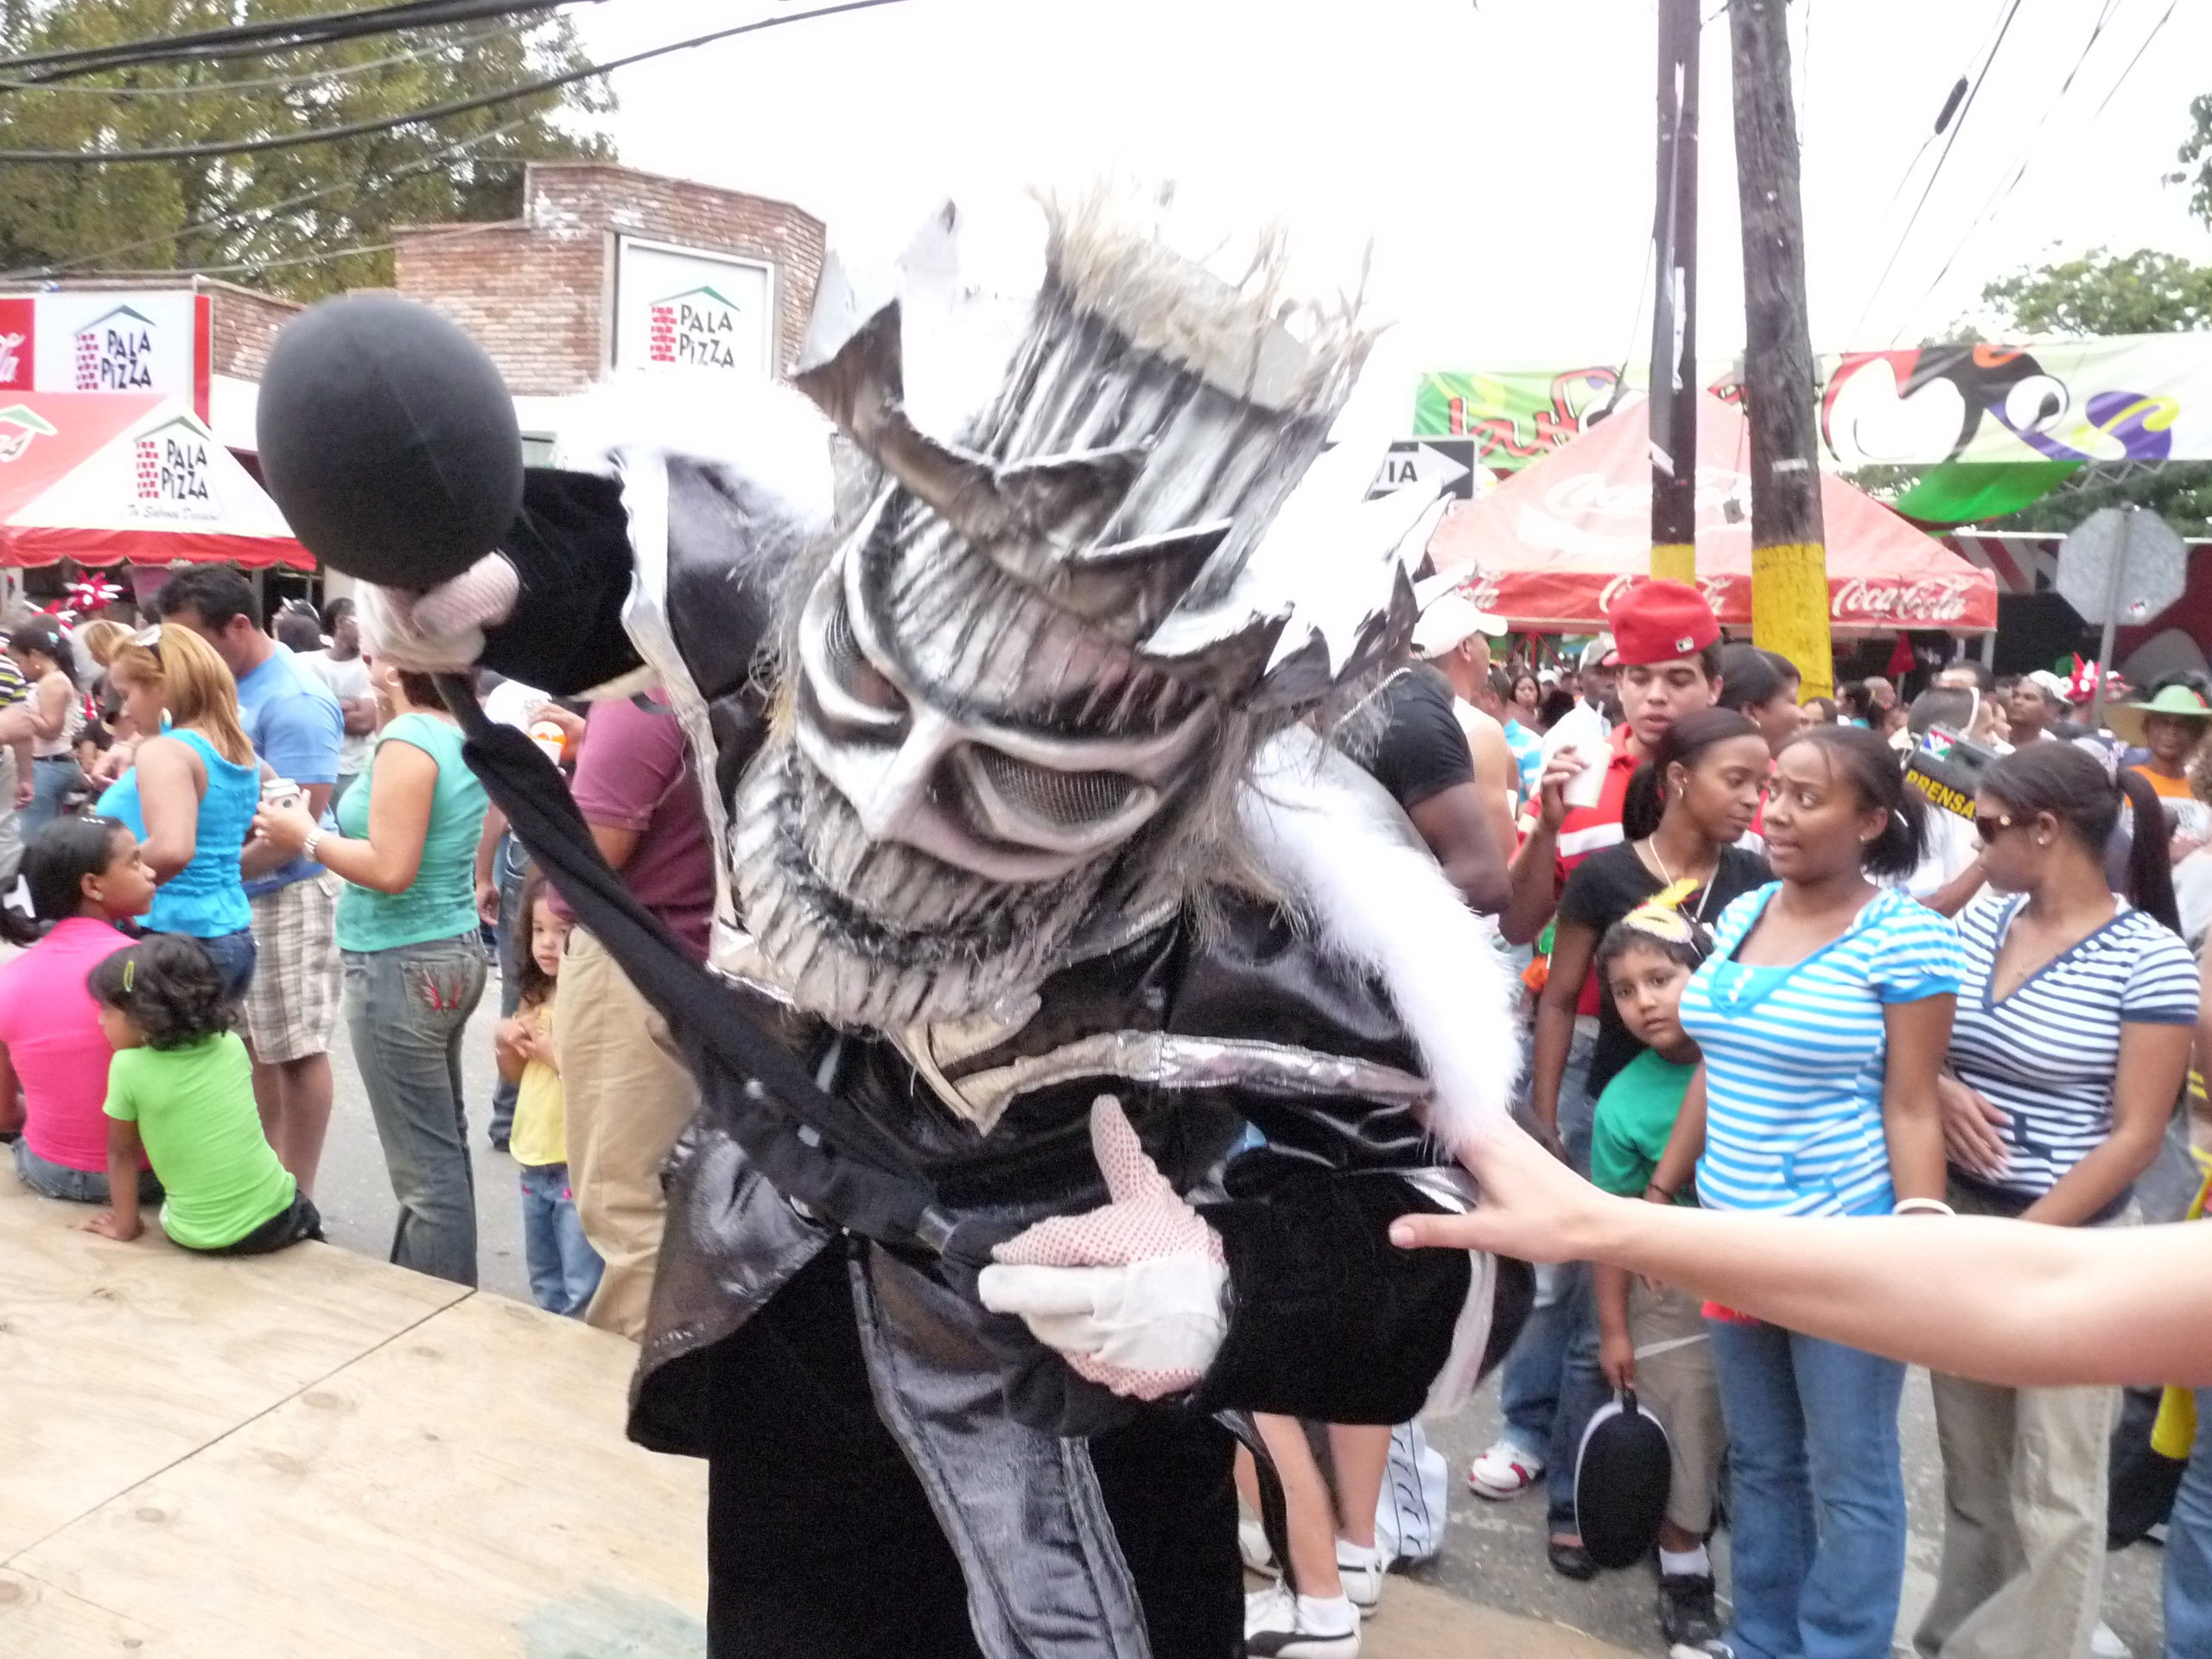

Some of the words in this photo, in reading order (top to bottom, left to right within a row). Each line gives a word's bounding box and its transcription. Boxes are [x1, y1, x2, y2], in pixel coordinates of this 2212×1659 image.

[681, 303, 734, 334] PALA
[107, 329, 152, 359] PALA
[167, 437, 207, 469] PALA
[1376, 460, 1419, 483] IA
[1905, 768, 1976, 819] PRENSA
